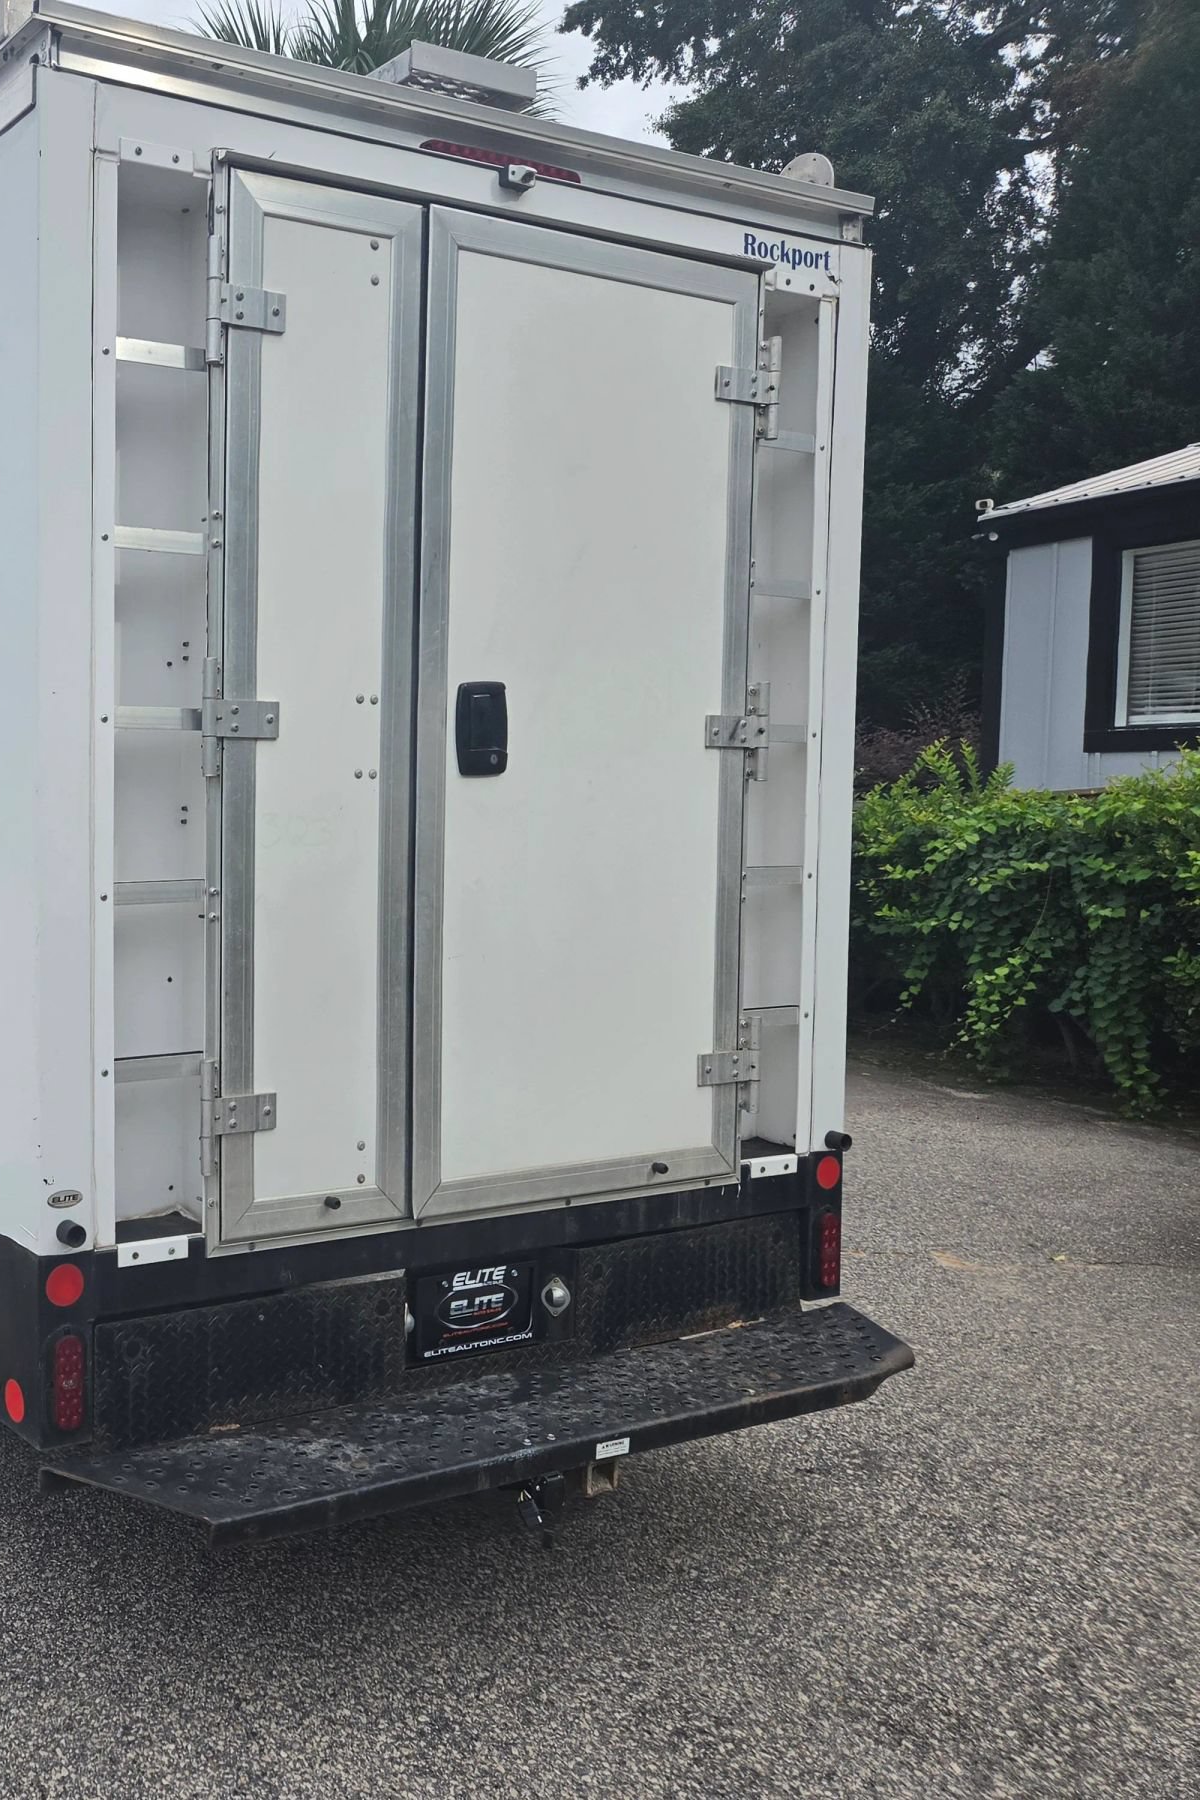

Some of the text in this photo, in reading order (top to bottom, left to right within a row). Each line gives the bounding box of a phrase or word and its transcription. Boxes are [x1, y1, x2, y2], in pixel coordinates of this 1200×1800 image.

[743, 232, 831, 271] Rockport
[51, 1193, 80, 1204] ELITE
[452, 1265, 507, 1287] ELITE
[450, 1292, 505, 1316] ELITE
[424, 1332, 533, 1358] ELITEAUTONC.COM
